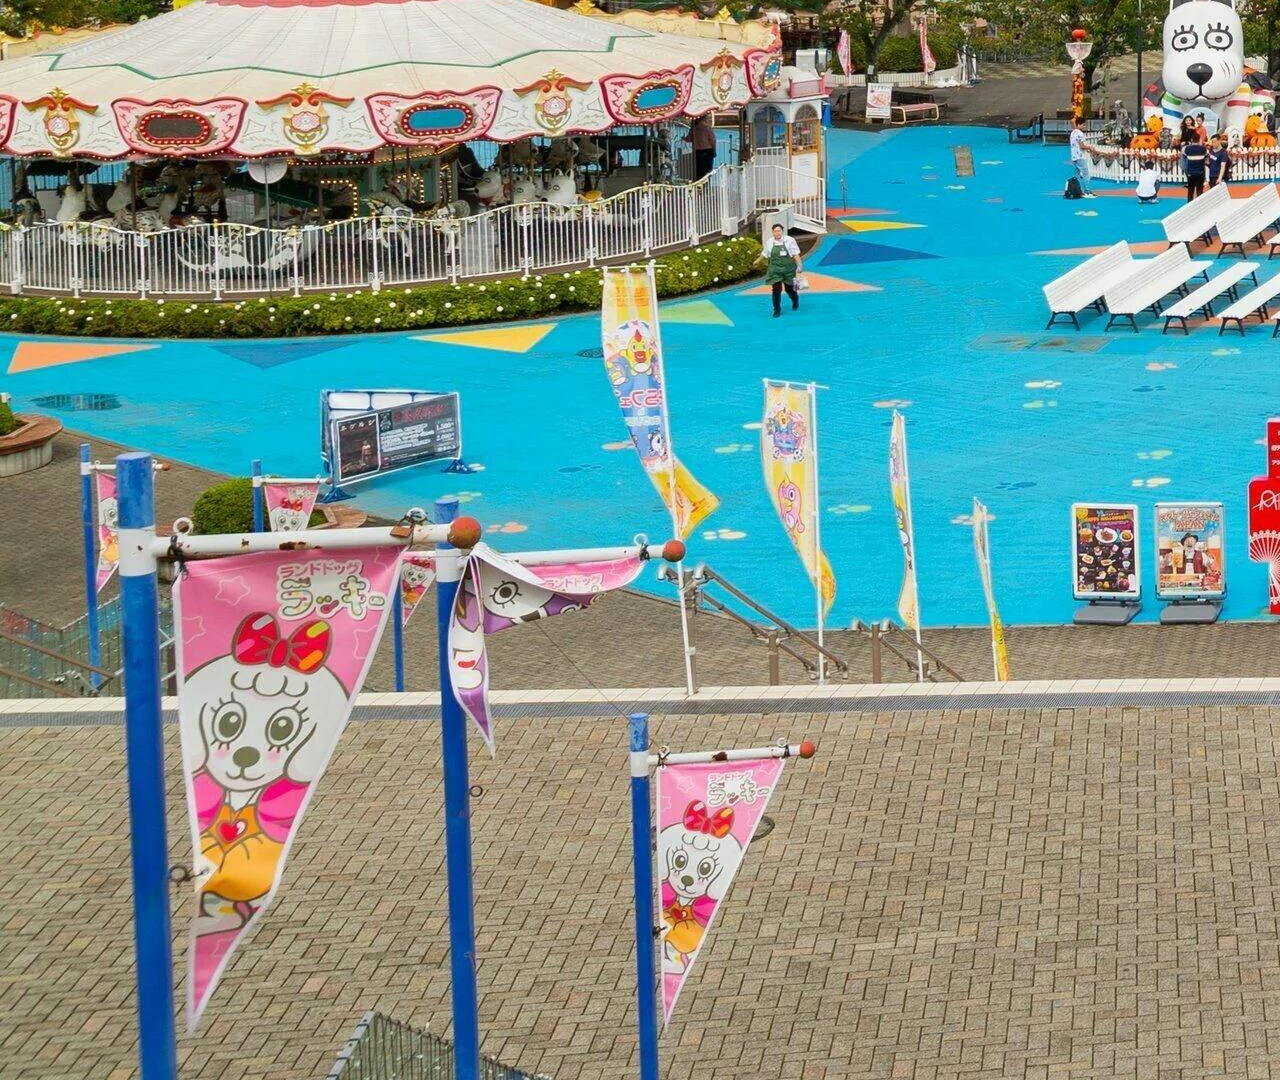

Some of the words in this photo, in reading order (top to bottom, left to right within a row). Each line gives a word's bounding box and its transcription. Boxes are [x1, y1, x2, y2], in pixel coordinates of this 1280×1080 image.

[280, 561, 359, 579] ランドドッグ
[280, 575, 386, 617] ラッキー
